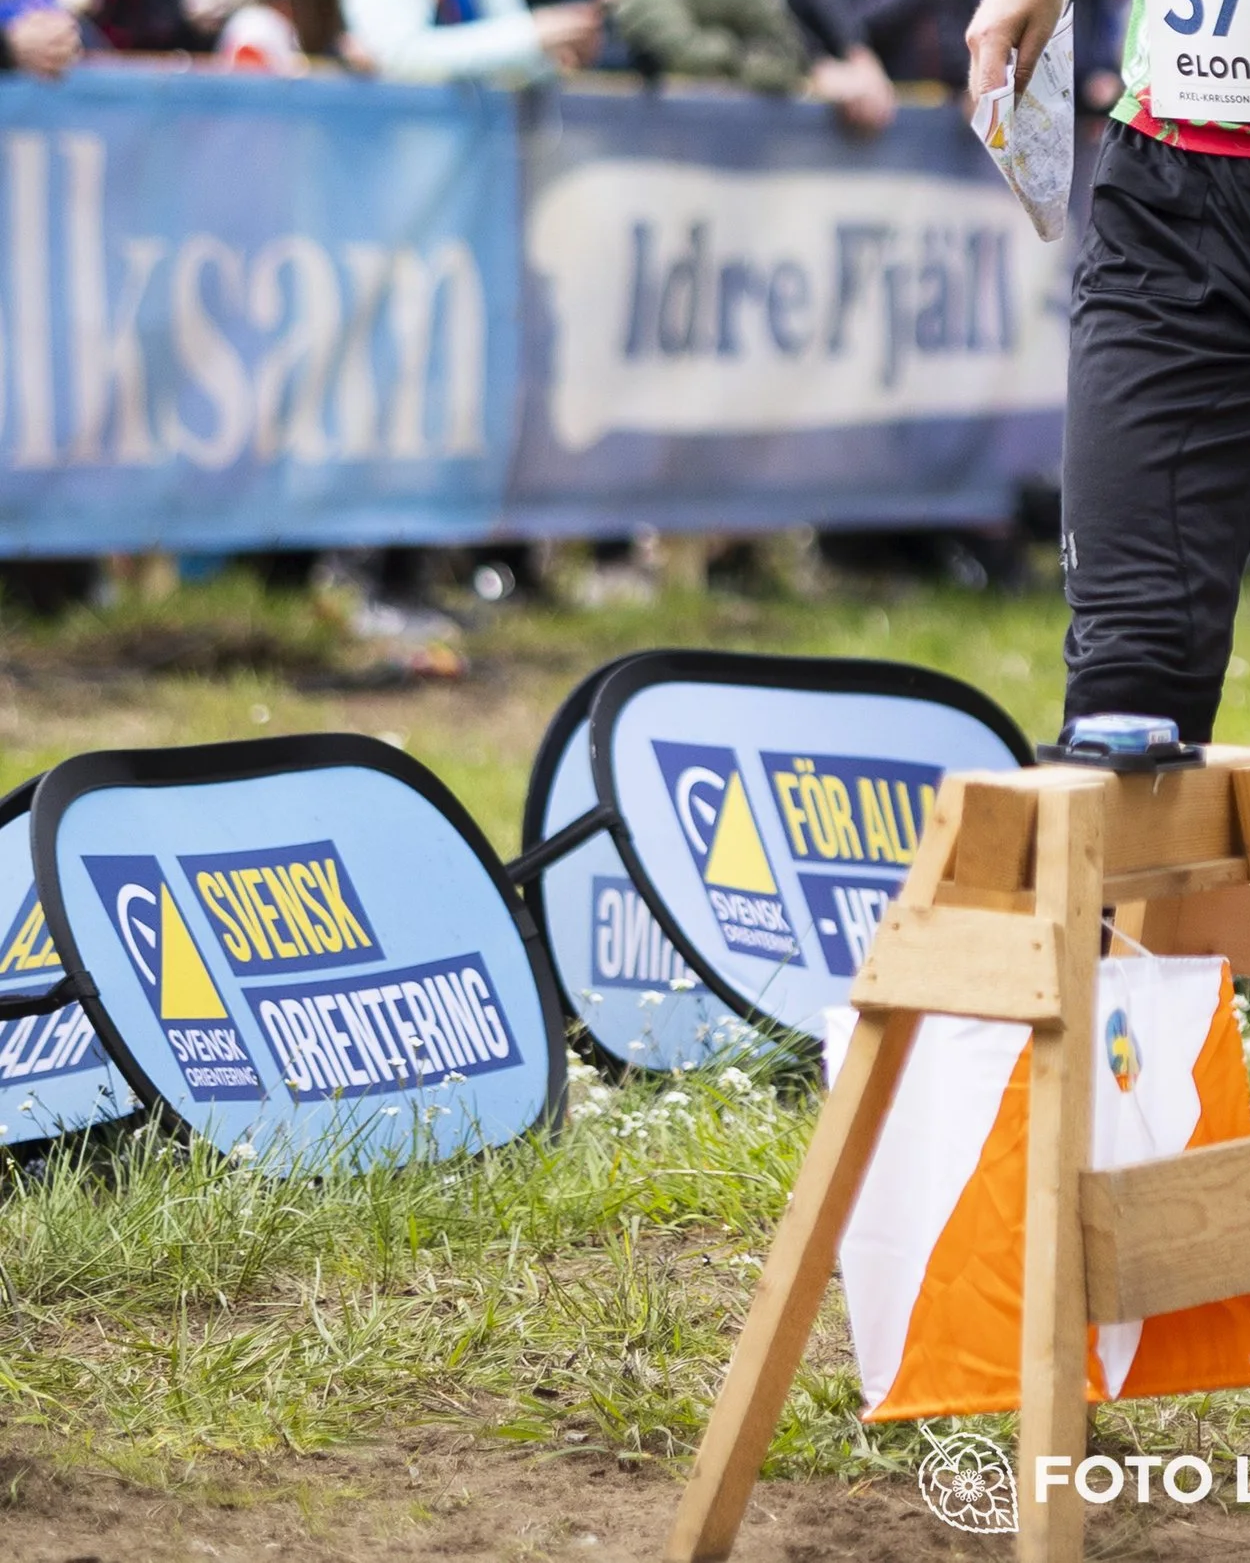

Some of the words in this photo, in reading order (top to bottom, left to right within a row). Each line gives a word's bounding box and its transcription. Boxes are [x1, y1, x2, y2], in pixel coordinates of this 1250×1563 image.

[0, 130, 490, 472] lksam
[773, 757, 864, 861] FÖR
[196, 858, 373, 963] SVENSK
[709, 889, 791, 933] SVENSK
[168, 1028, 248, 1063] SVENSK
[185, 1066, 258, 1088] ORIENTERING
[259, 967, 510, 1093] ORIENTERING
